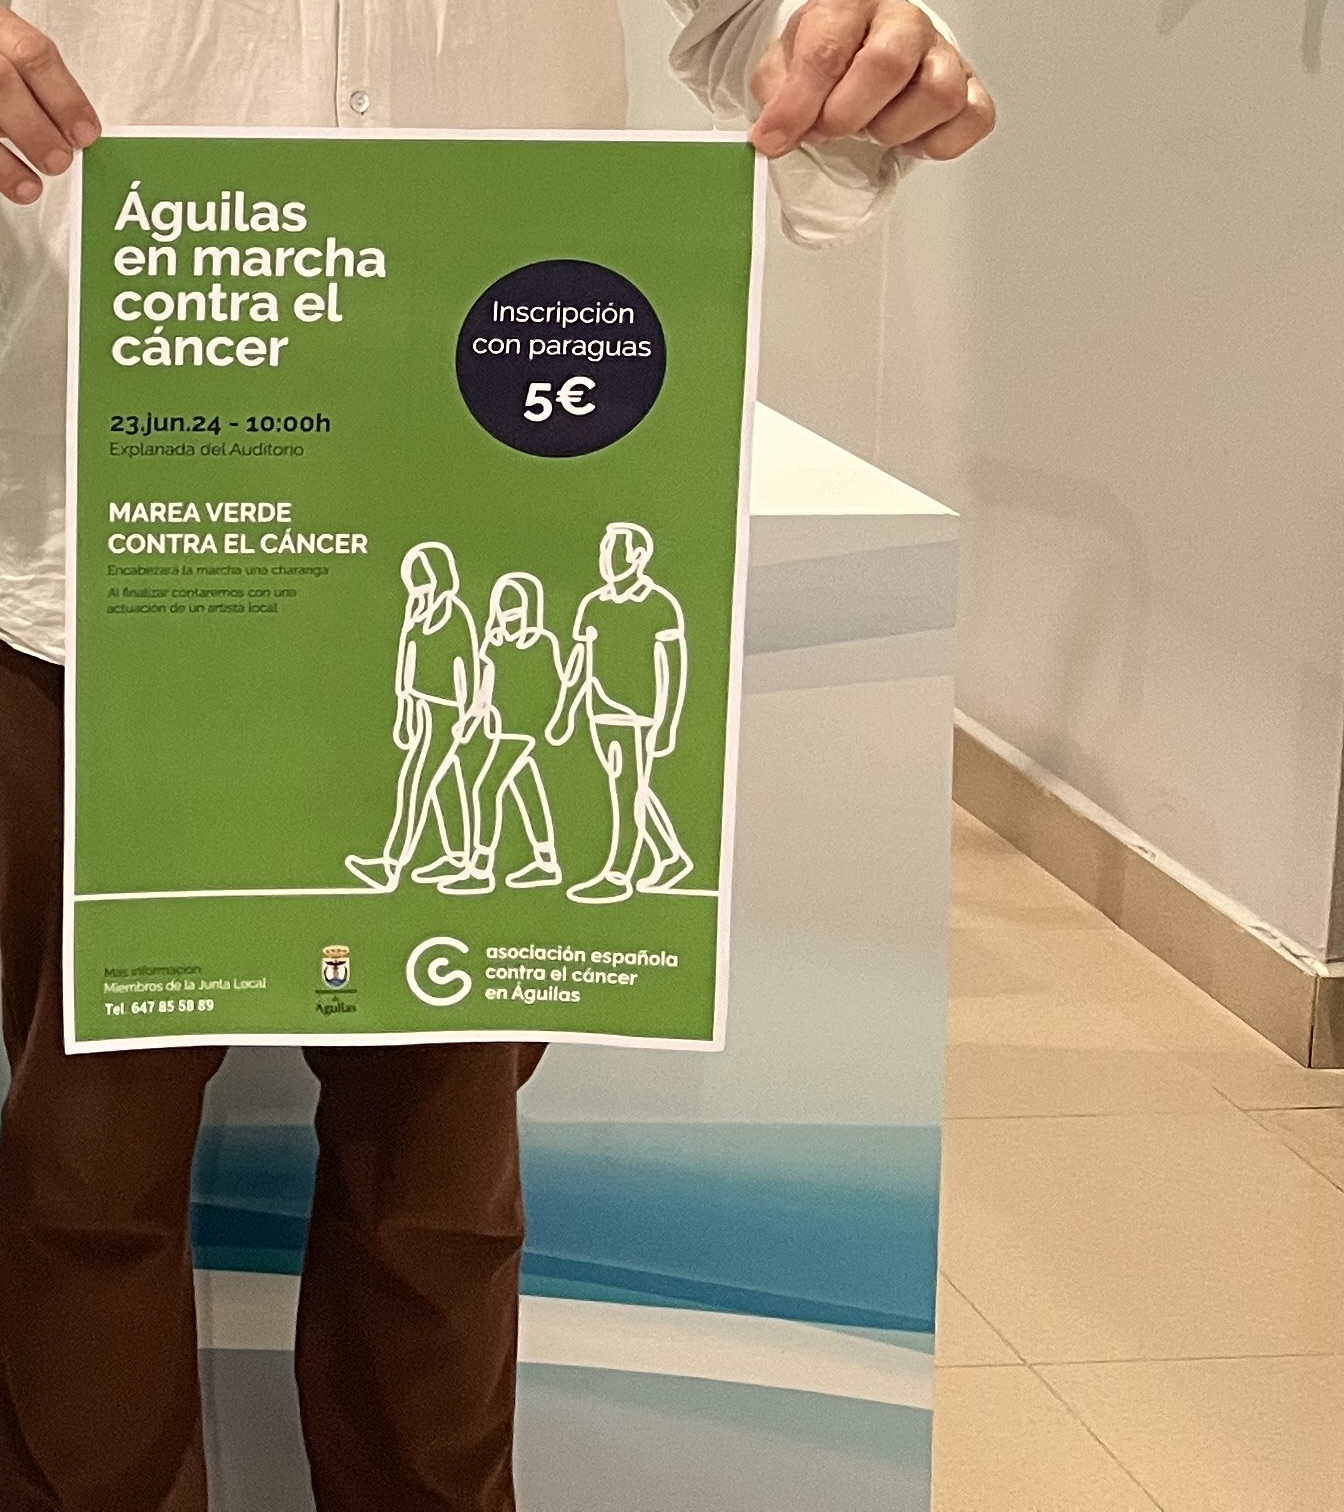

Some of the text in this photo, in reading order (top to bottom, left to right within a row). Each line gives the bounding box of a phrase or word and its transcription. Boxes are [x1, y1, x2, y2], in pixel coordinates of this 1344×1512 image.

[114, 180, 307, 243] Águilas
[114, 237, 386, 278] en marcha
[112, 282, 343, 323] contra el
[493, 300, 634, 329] Inscripción
[111, 325, 289, 367] cáncer
[472, 337, 652, 362] con paraguas
[523, 375, 596, 423] 5€
[110, 412, 222, 436] 23.jun.24
[246, 413, 331, 433] 10:00h
[109, 441, 305, 459] Explanada del Auditorio
[109, 502, 292, 523] MAREA VERDE
[108, 528, 368, 554] CONTRA EL CÁNCER
[486, 944, 678, 968] asociación española
[233, 978, 267, 990] Local
[485, 965, 638, 986] contra el cáncer
[485, 981, 581, 1005] en Águilas
[131, 1001, 156, 1015] 647
